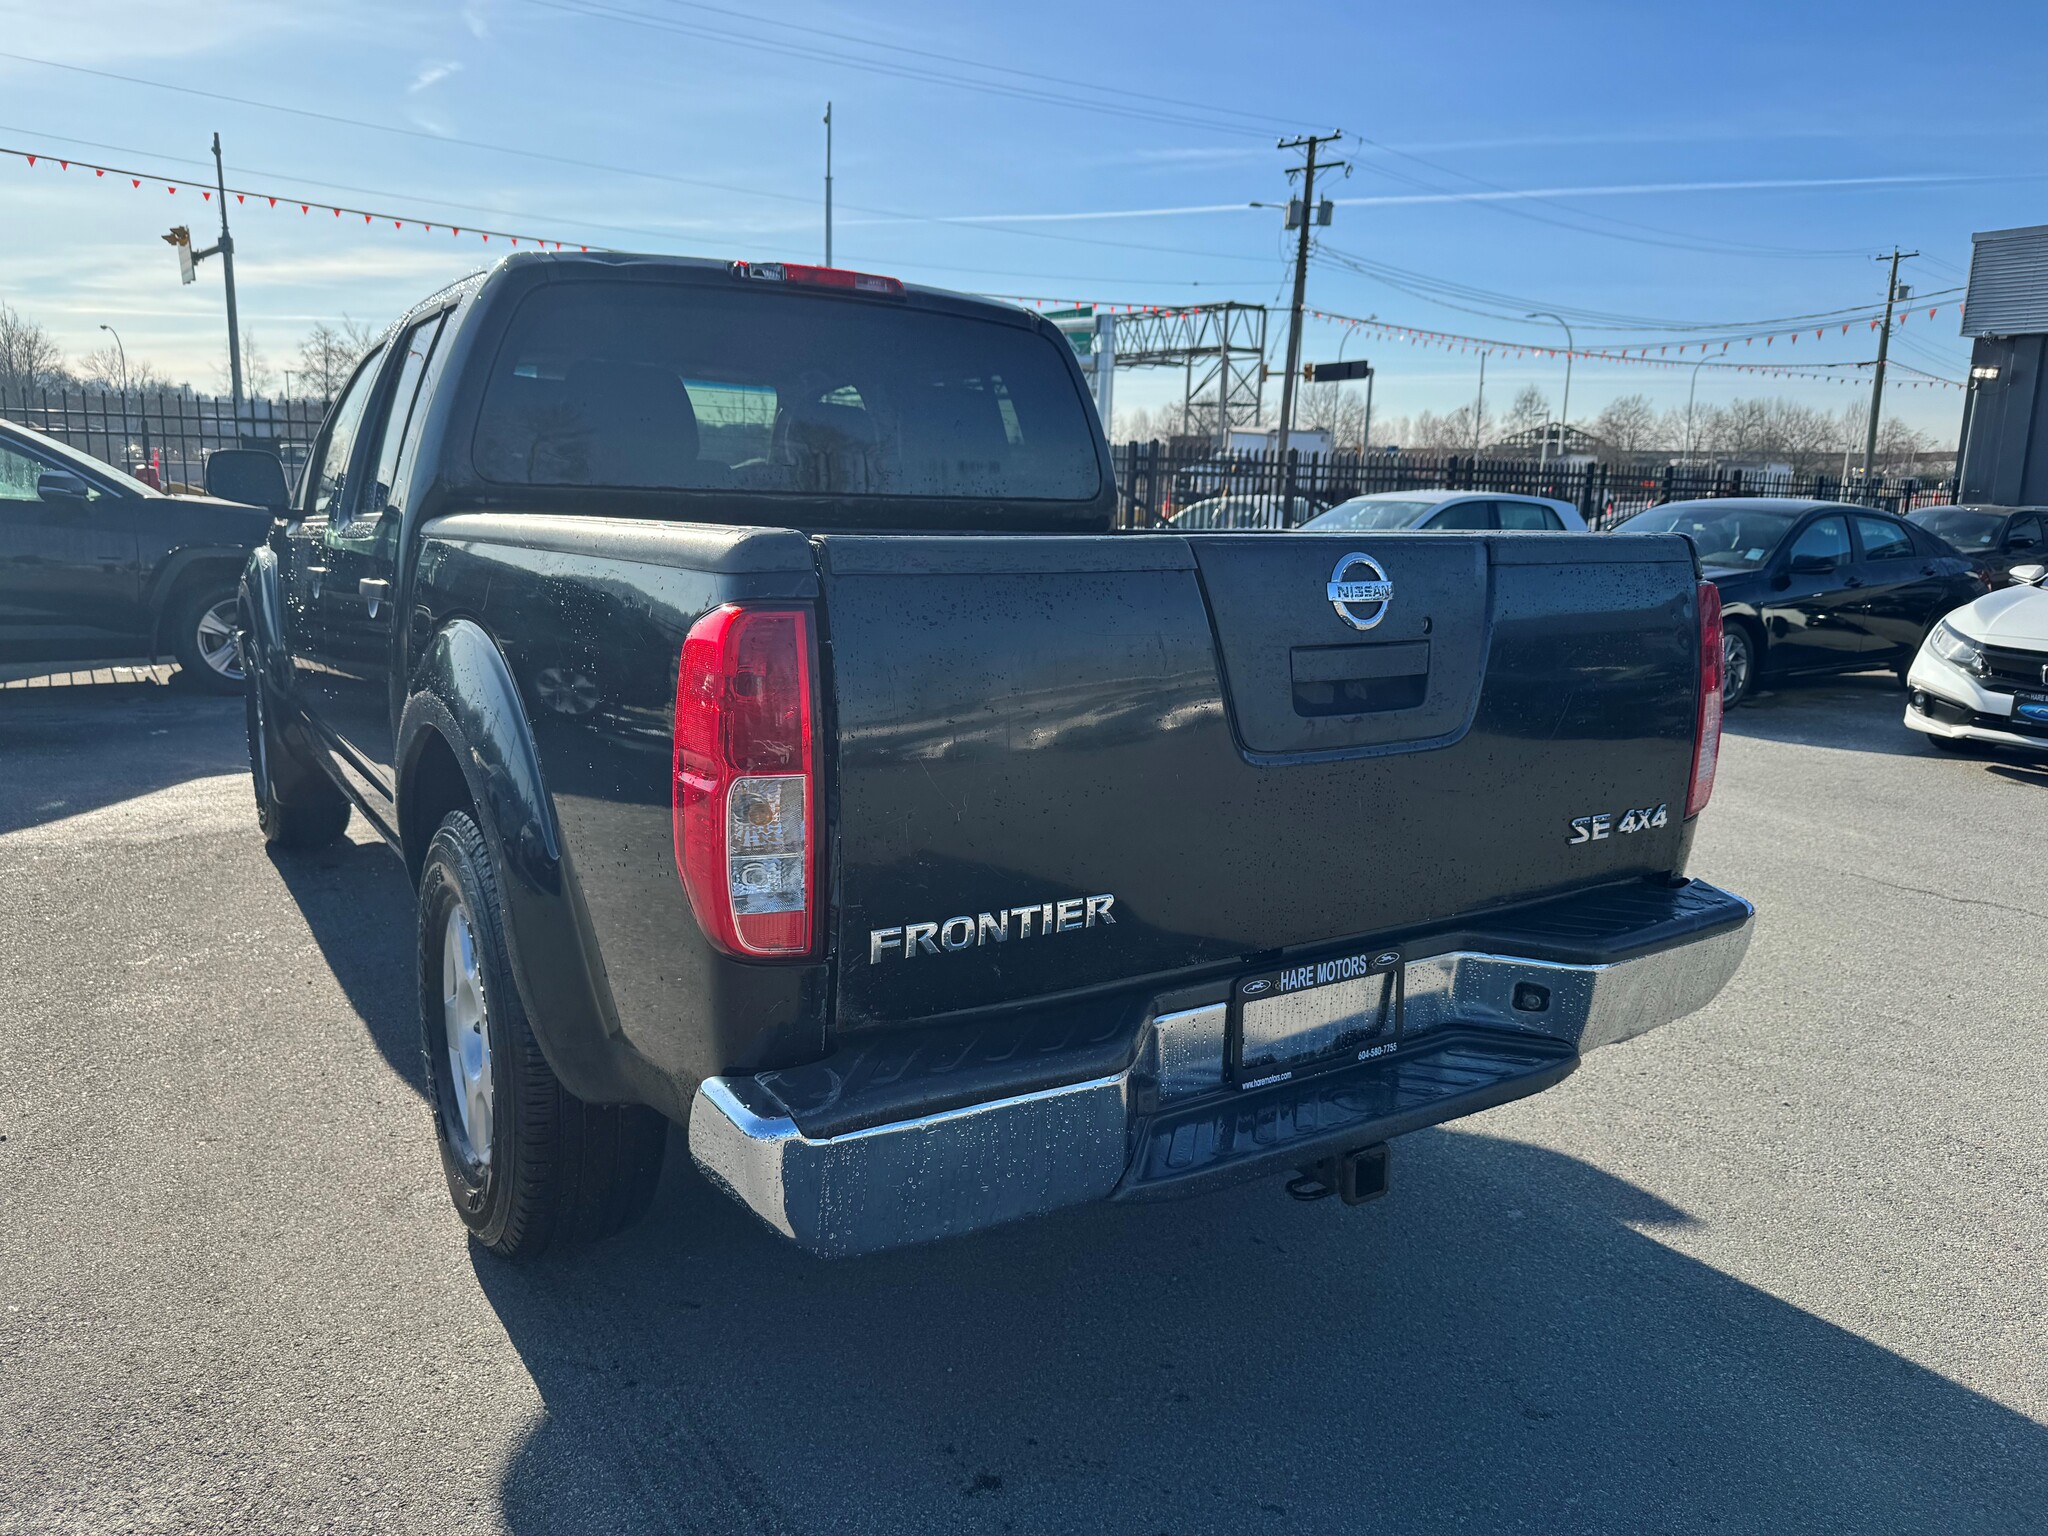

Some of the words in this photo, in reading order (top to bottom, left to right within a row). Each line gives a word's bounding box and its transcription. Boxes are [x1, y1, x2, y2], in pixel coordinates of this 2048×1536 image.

[1336, 584, 1391, 599] NISSAN
[1569, 813, 1611, 844] SE
[870, 893, 1117, 965] FRONTIER
[1280, 965, 1315, 992] HARE
[1317, 954, 1367, 984] MOTORS
[1357, 1042, 1398, 1061] 604-580-7755
[1241, 1071, 1292, 1090] www.haremotors.com
